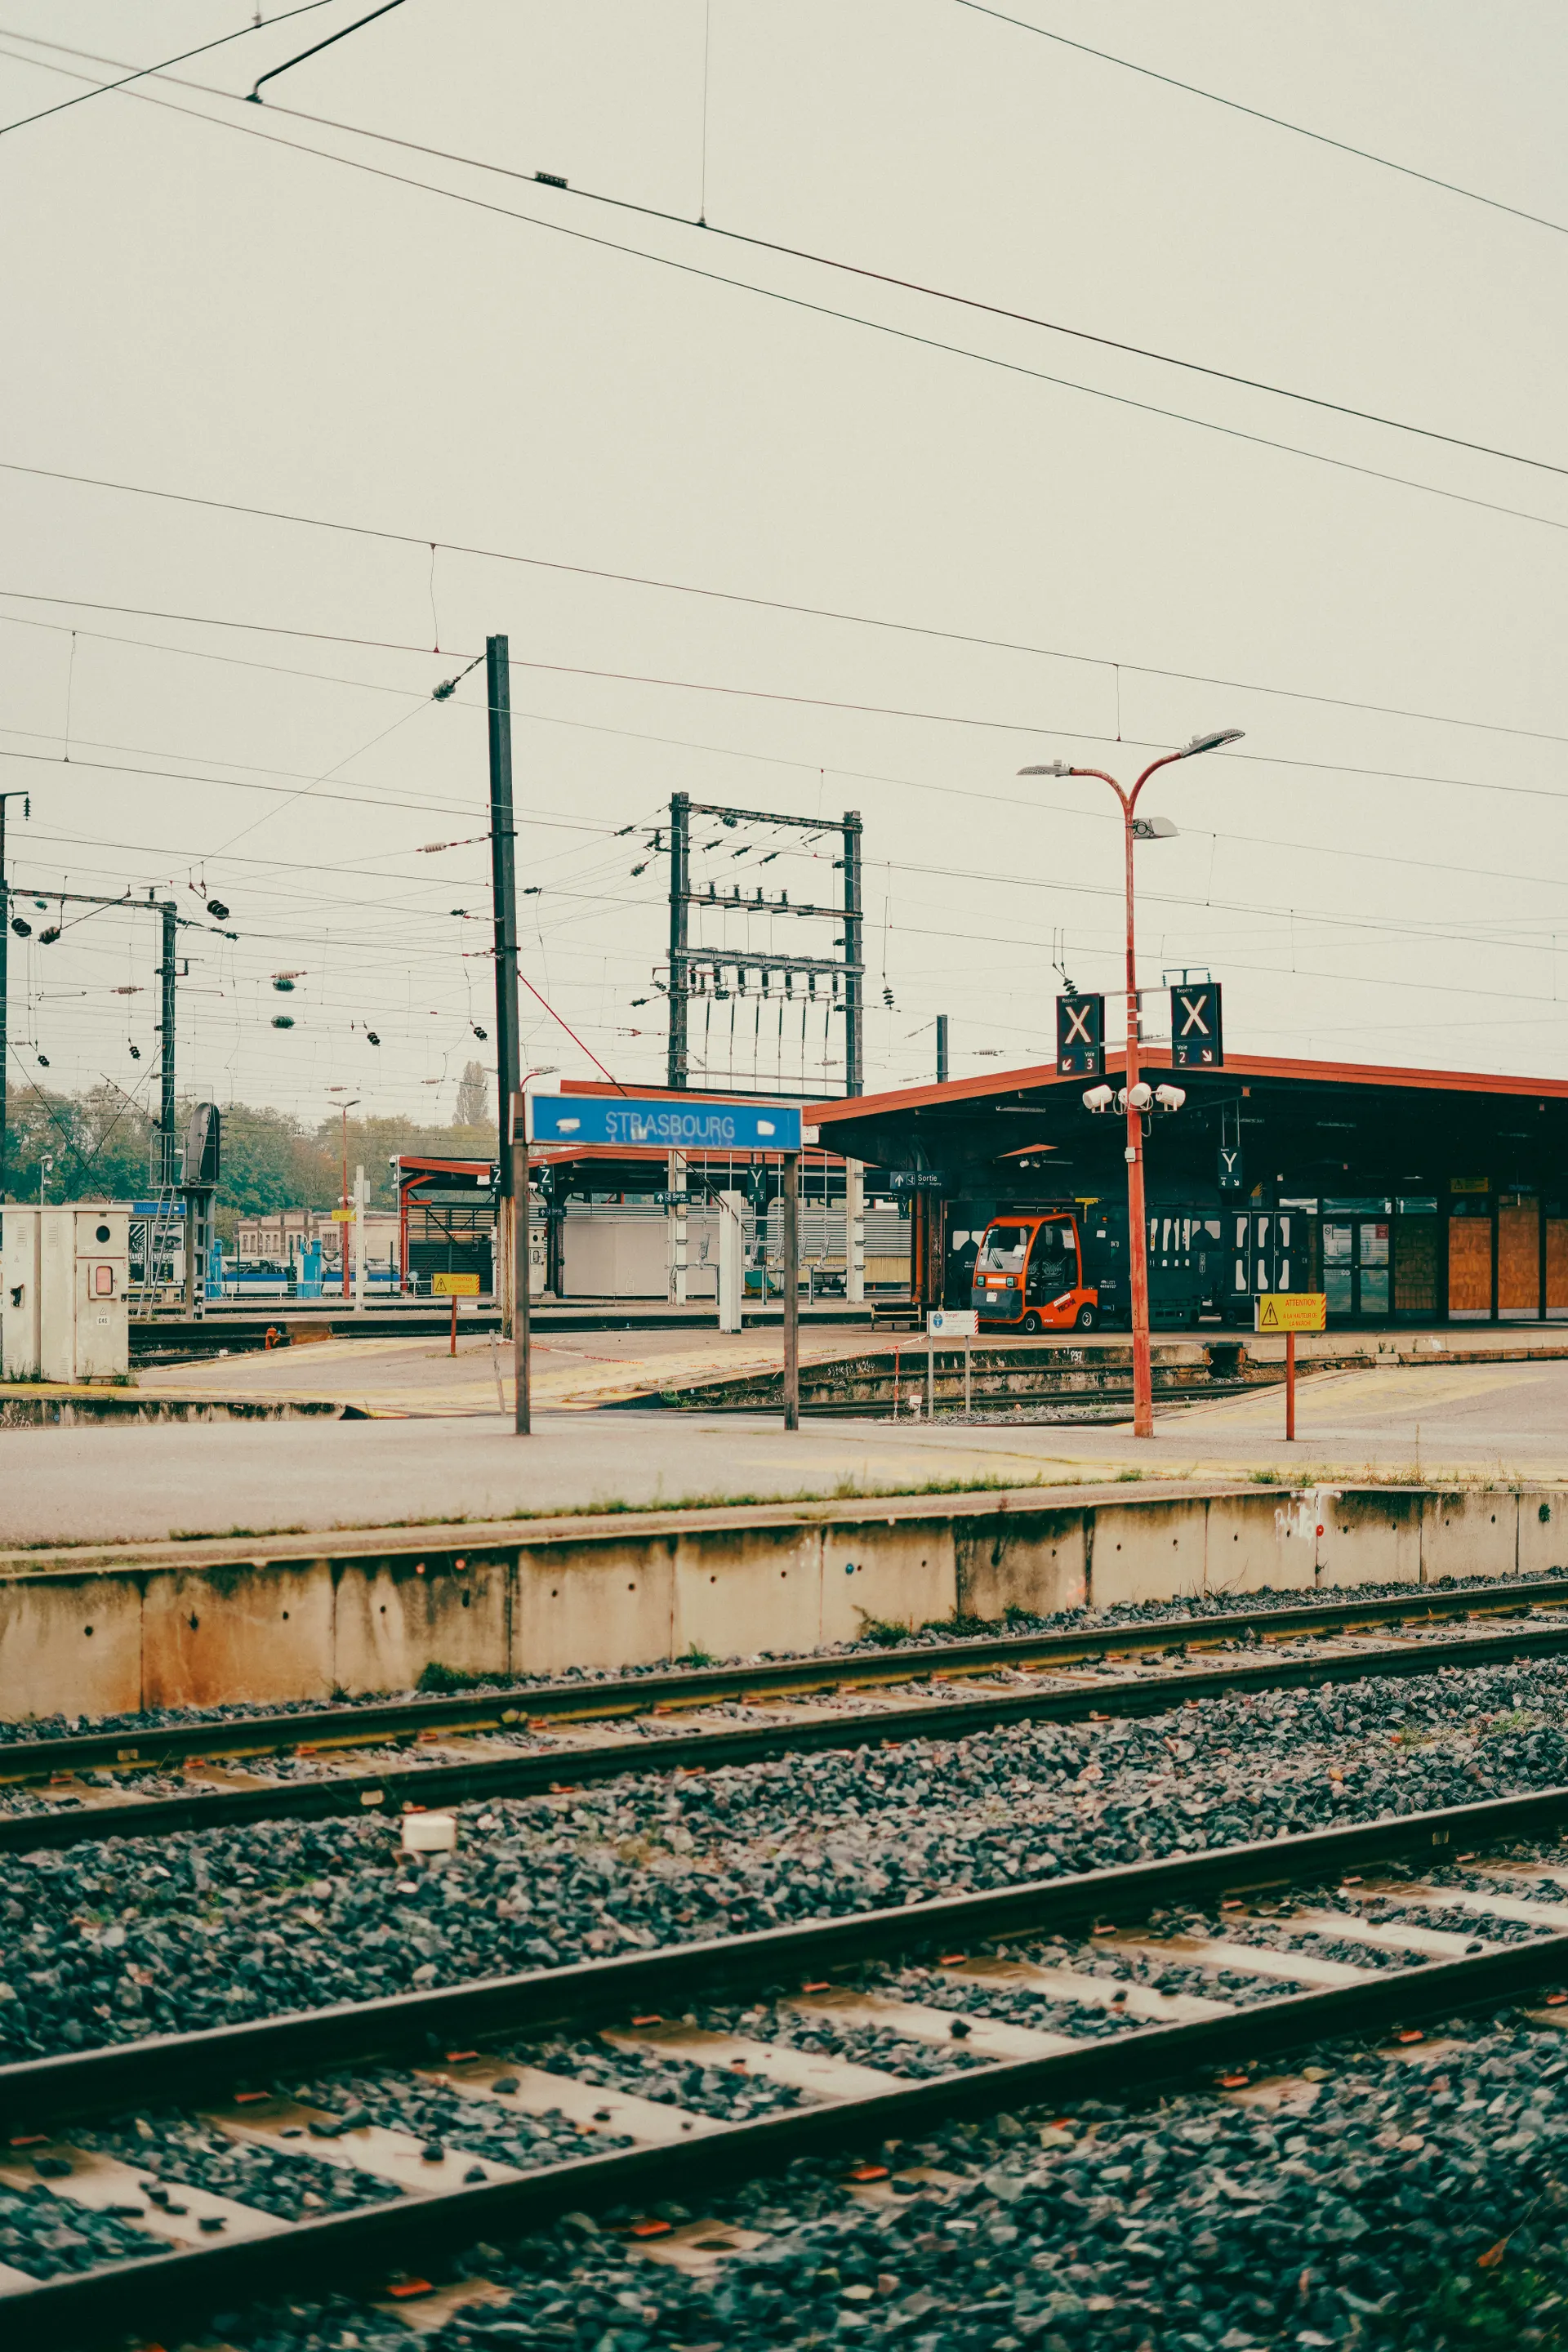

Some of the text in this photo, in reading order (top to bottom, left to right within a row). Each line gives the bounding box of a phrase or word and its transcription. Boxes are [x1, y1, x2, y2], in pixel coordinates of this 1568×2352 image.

[1180, 995, 1209, 1036] X
[1064, 1004, 1092, 1045] X
[1086, 1058, 1093, 1070] 3
[1178, 1052, 1186, 1063] 2
[605, 1111, 735, 1138] STRASBOURG
[1222, 1152, 1237, 1173] Y
[493, 1169, 501, 1183] Z
[541, 1169, 550, 1183] Z
[751, 1169, 763, 1187] Y
[917, 1174, 938, 1182] Sortie
[1285, 1298, 1316, 1307] ATTENTION
